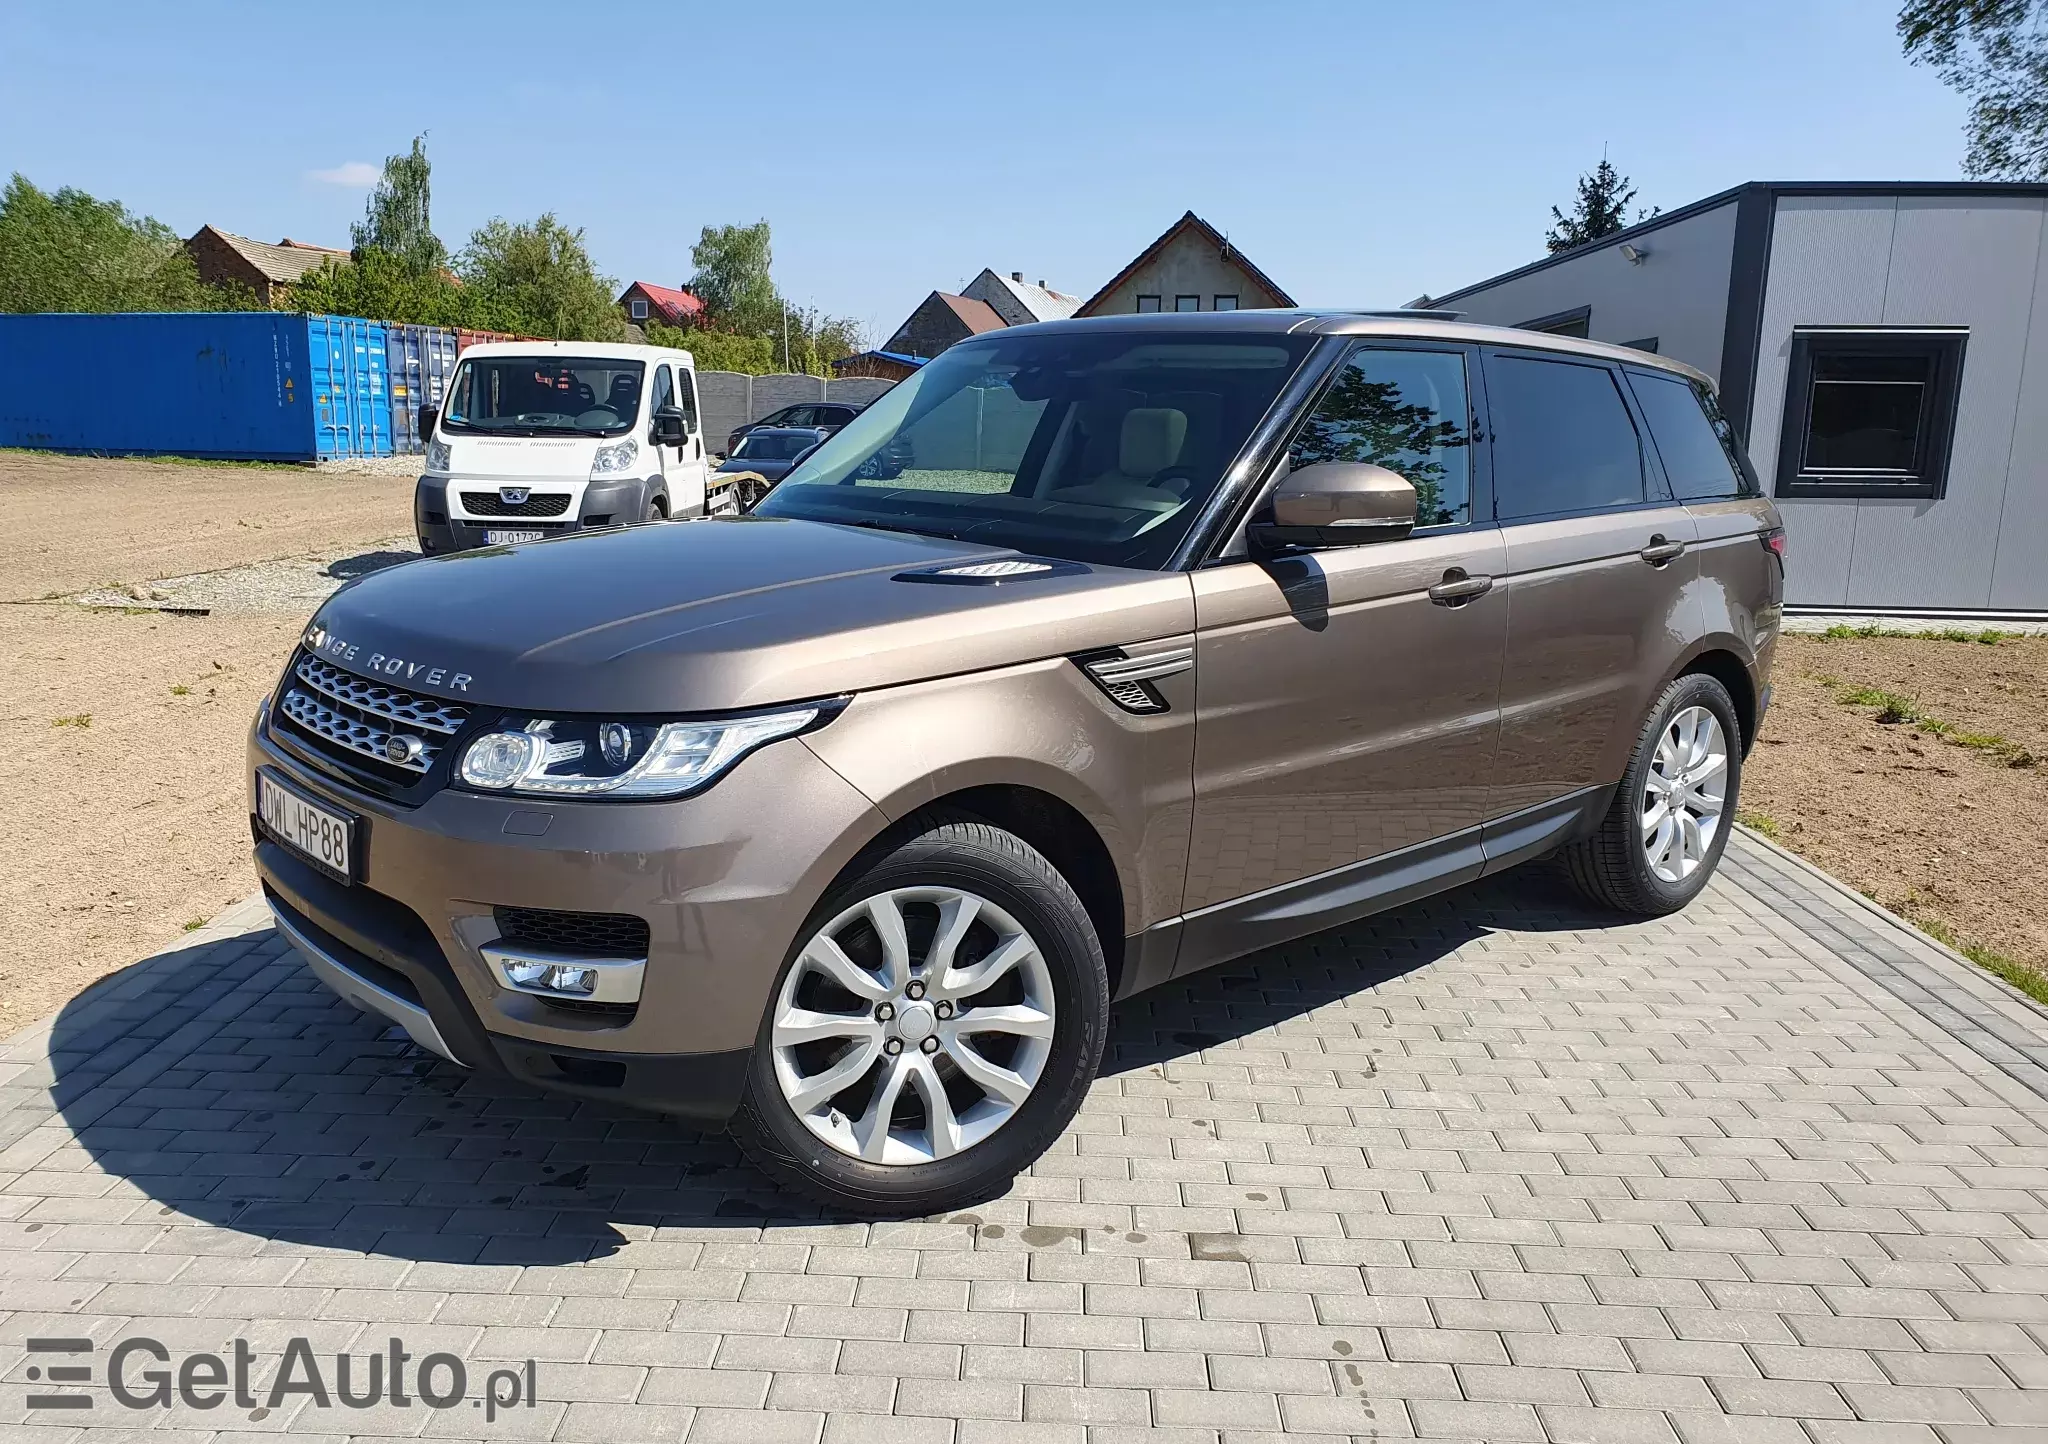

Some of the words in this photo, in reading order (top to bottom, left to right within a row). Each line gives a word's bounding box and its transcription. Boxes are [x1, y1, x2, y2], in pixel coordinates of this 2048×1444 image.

[490, 531, 503, 543] DJ
[366, 652, 472, 692] ROVER
[265, 781, 293, 839] DWL
[297, 802, 345, 867] HP88
